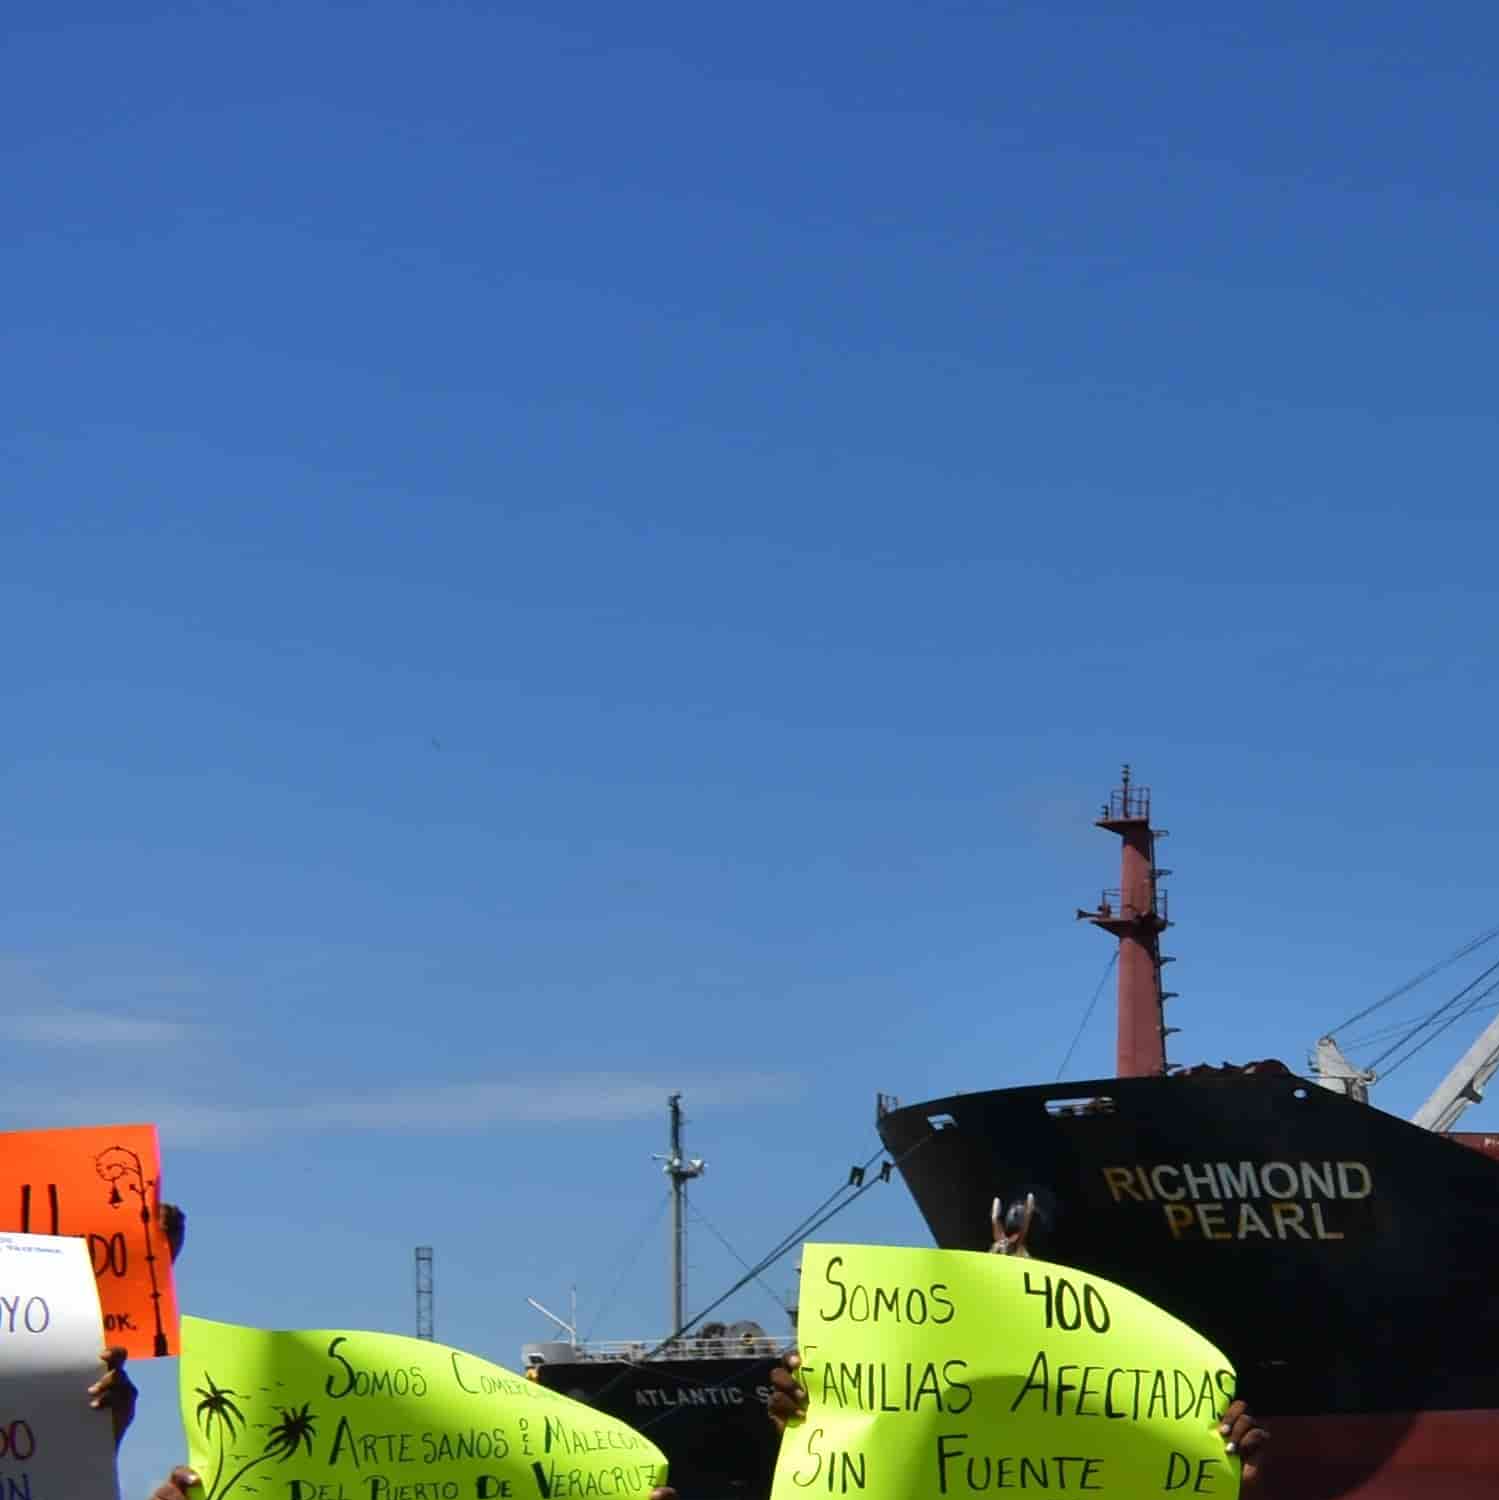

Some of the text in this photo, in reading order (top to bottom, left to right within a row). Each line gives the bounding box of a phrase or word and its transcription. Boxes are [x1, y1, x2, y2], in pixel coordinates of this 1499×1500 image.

[1103, 1161, 1373, 1200] RICHMOND
[1163, 1202, 1344, 1240] PEARL
[820, 1257, 1110, 1333] SOMOS 400
[325, 1337, 427, 1399] SOMOS
[635, 1386, 744, 1406] ATLANTIC
[799, 1346, 1237, 1422] FAMILIAS AFECTADAS
[328, 1415, 509, 1471] ARTESANOS
[793, 1429, 1223, 1494] SIN FUENTE DE
[476, 1474, 513, 1500] DE
[530, 1459, 658, 1500] VERACRUZ
